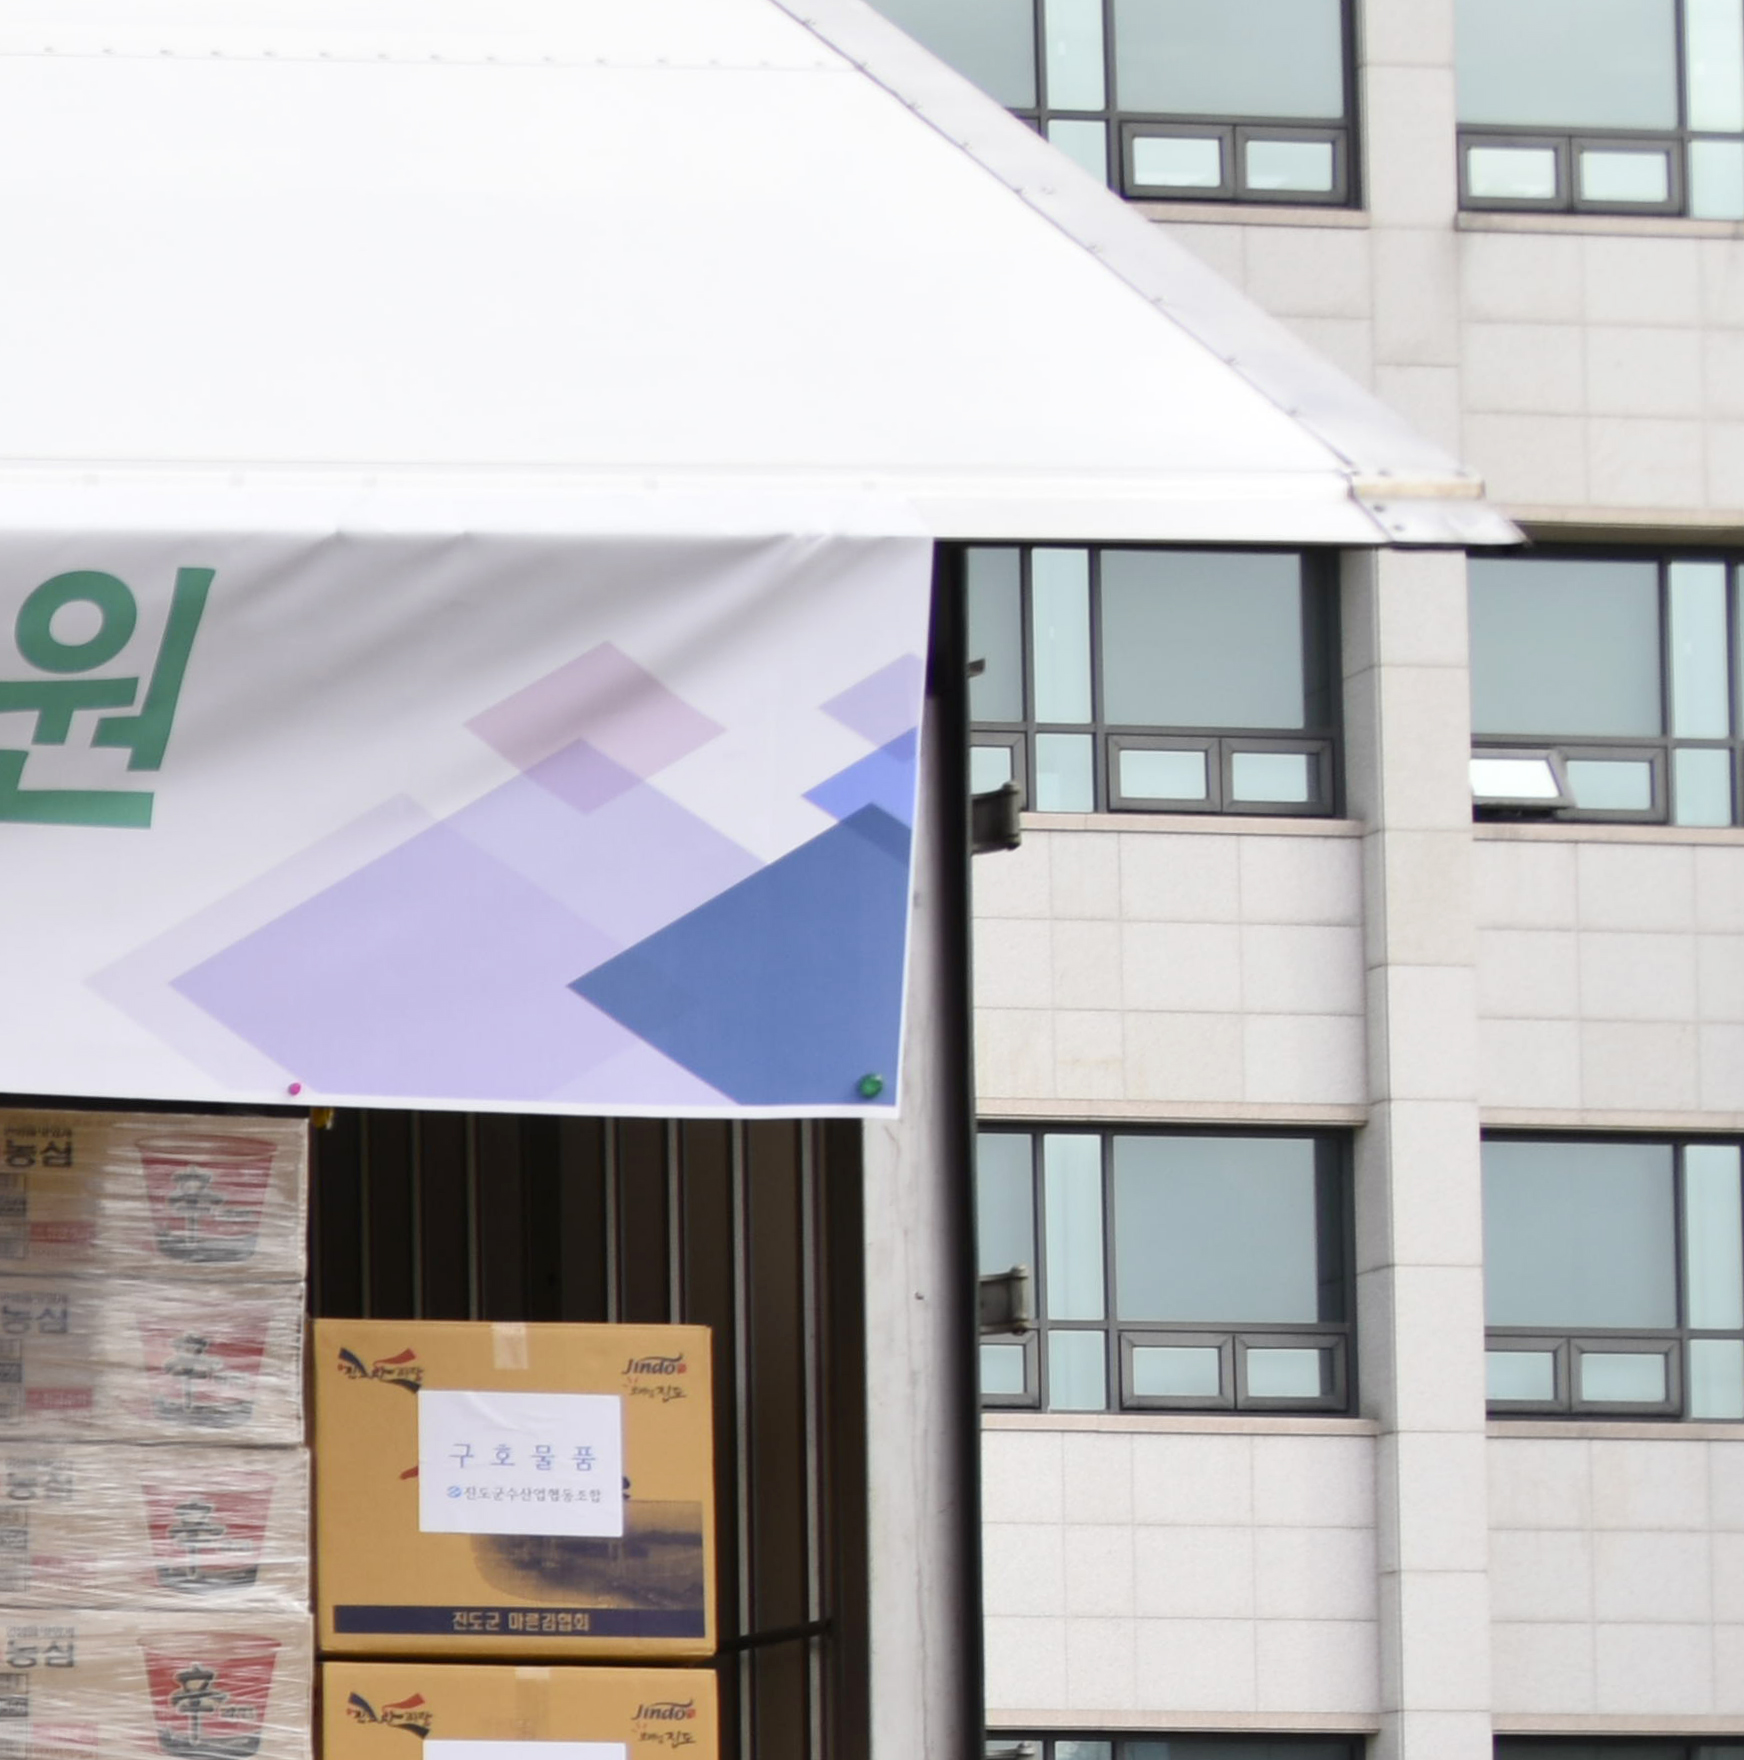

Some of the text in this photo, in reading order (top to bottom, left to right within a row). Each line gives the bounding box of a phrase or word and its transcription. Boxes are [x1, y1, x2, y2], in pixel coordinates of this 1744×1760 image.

[4, 1140, 74, 1168] 농심
[1, 1303, 69, 1334] 농심
[6, 1642, 76, 1668] 농심
